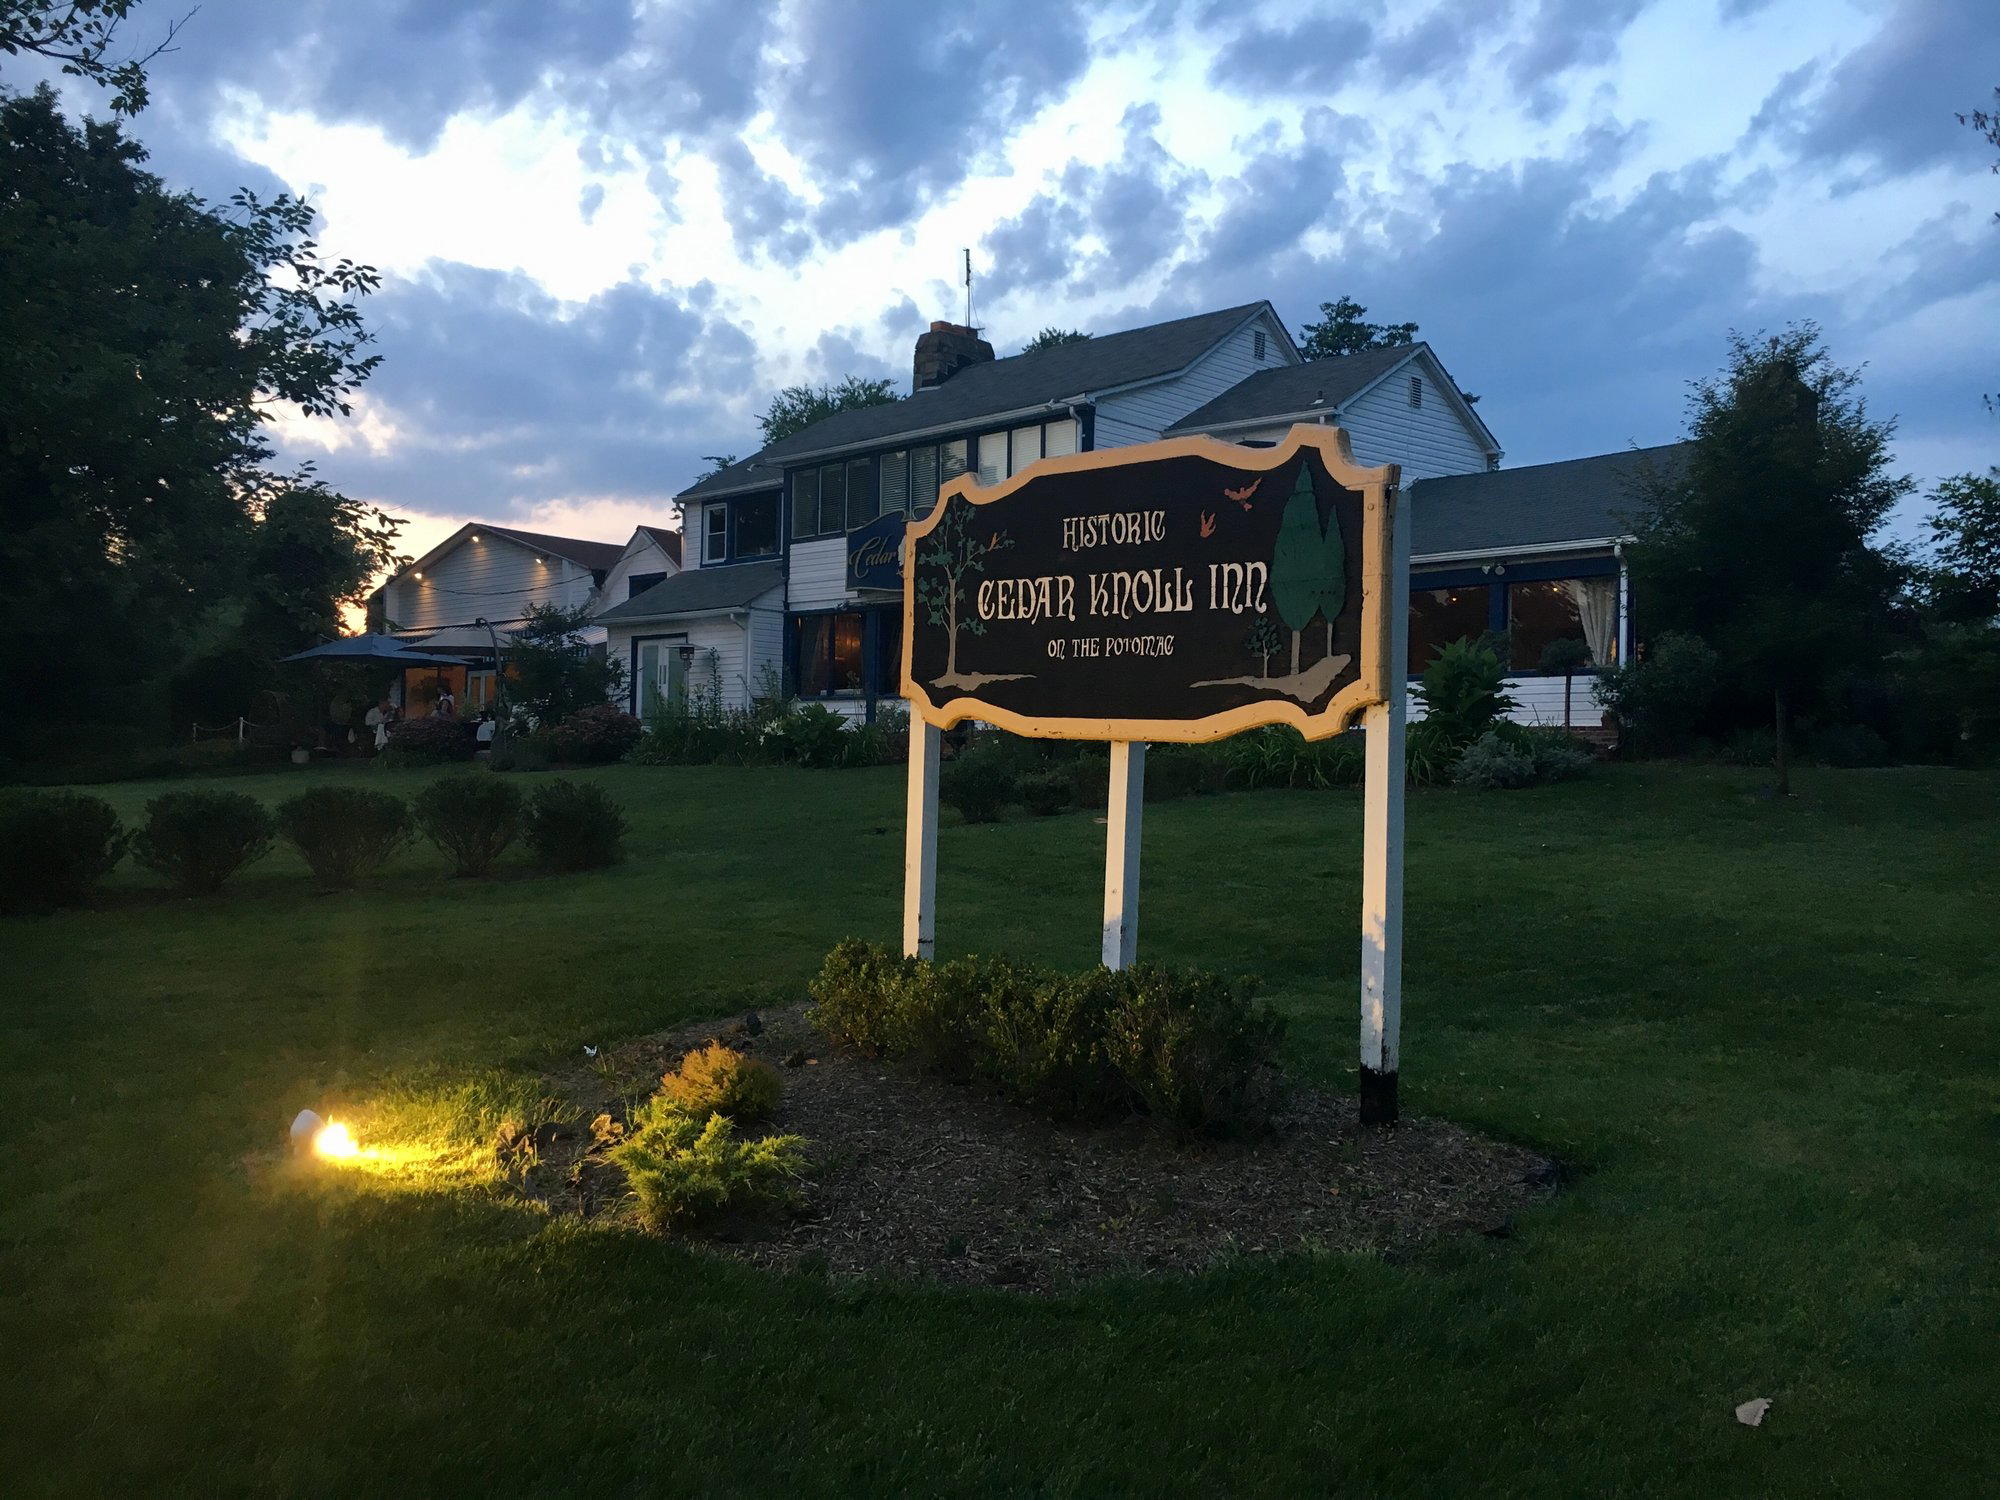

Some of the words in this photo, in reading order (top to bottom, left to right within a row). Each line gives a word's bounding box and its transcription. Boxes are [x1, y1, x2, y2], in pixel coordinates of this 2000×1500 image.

[1062, 510, 1166, 551] HISTORIC
[978, 575, 1075, 624] CEDAR
[1089, 567, 1193, 619] KNOLL
[1208, 561, 1269, 614] INN
[1047, 638, 1066, 658] ON
[1072, 637, 1100, 657] THE
[1105, 635, 1175, 657] POTOMAC
